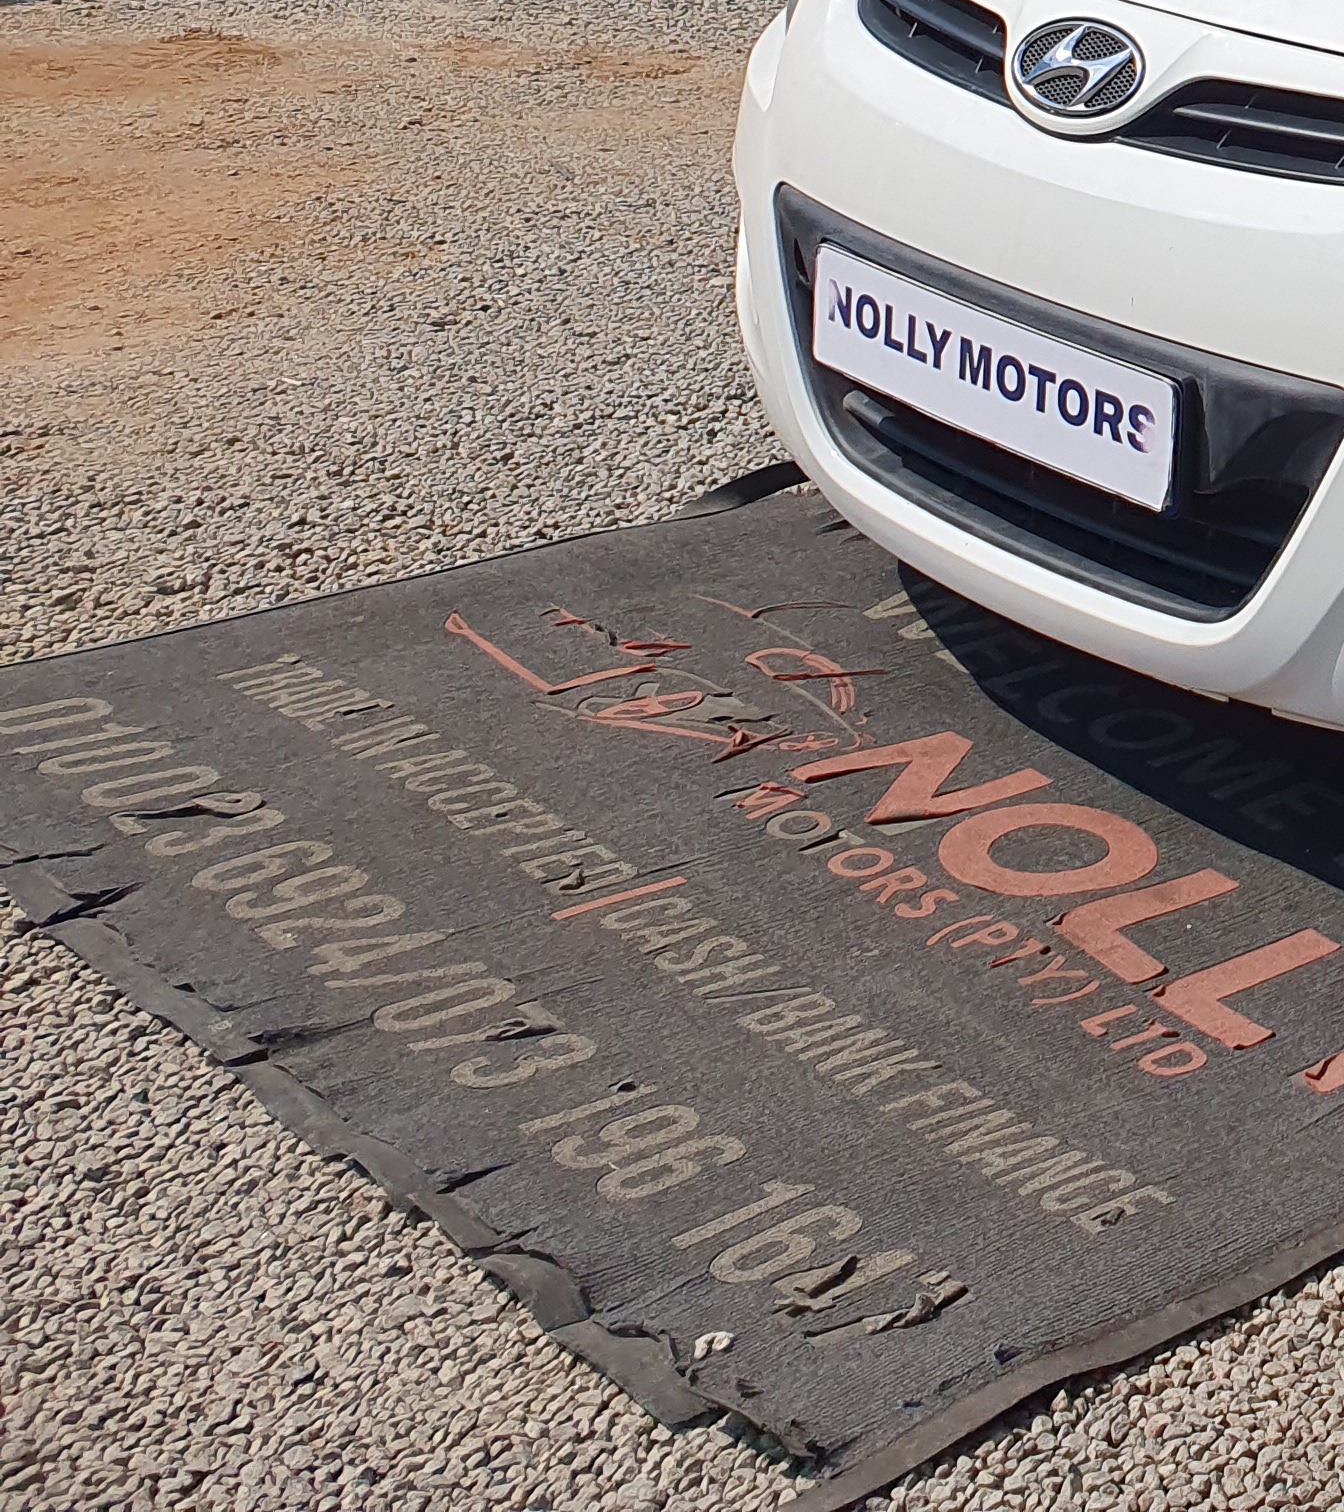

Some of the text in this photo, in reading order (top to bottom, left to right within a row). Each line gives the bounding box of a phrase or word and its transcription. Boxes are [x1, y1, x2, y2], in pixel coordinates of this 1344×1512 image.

[827, 277, 1158, 455] NOLLY MOTORS
[216, 653, 395, 731] TRADE
[331, 714, 442, 760] IN
[374, 749, 639, 896] ACCEPTED
[714, 780, 1208, 1078] MOTORS (PTY) LTD
[877, 1079, 1178, 1237] FINANCE
